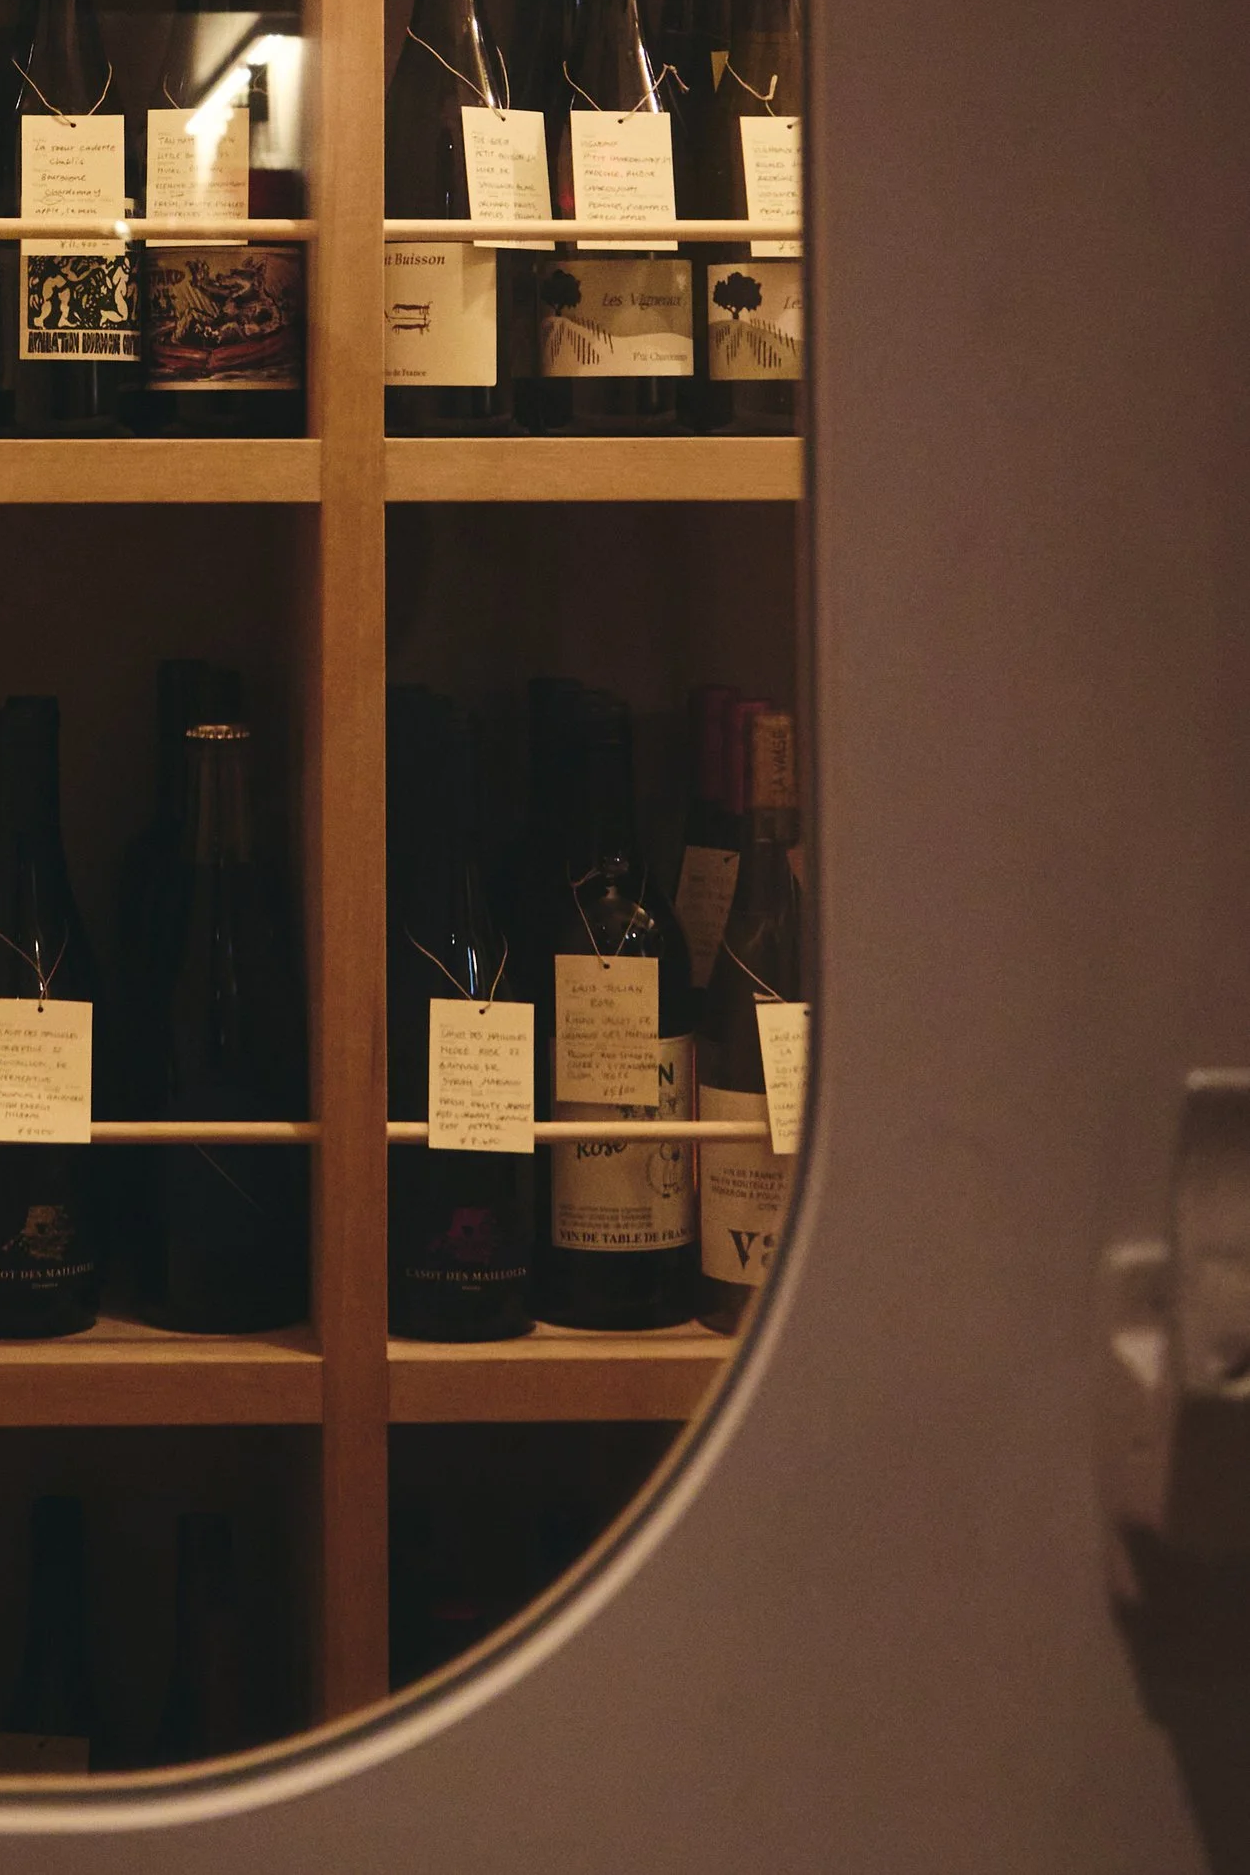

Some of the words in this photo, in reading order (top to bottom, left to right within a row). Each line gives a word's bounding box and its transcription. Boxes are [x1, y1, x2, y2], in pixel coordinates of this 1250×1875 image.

[394, 252, 446, 267] Buisson
[602, 292, 623, 308] Les
[628, 292, 682, 310] Vigneaux
[558, 1228, 580, 1242] VIN
[582, 1230, 598, 1243] DE
[601, 1232, 642, 1244] TABLE
[645, 1231, 659, 1243] DE
[20, 1269, 43, 1281] DES
